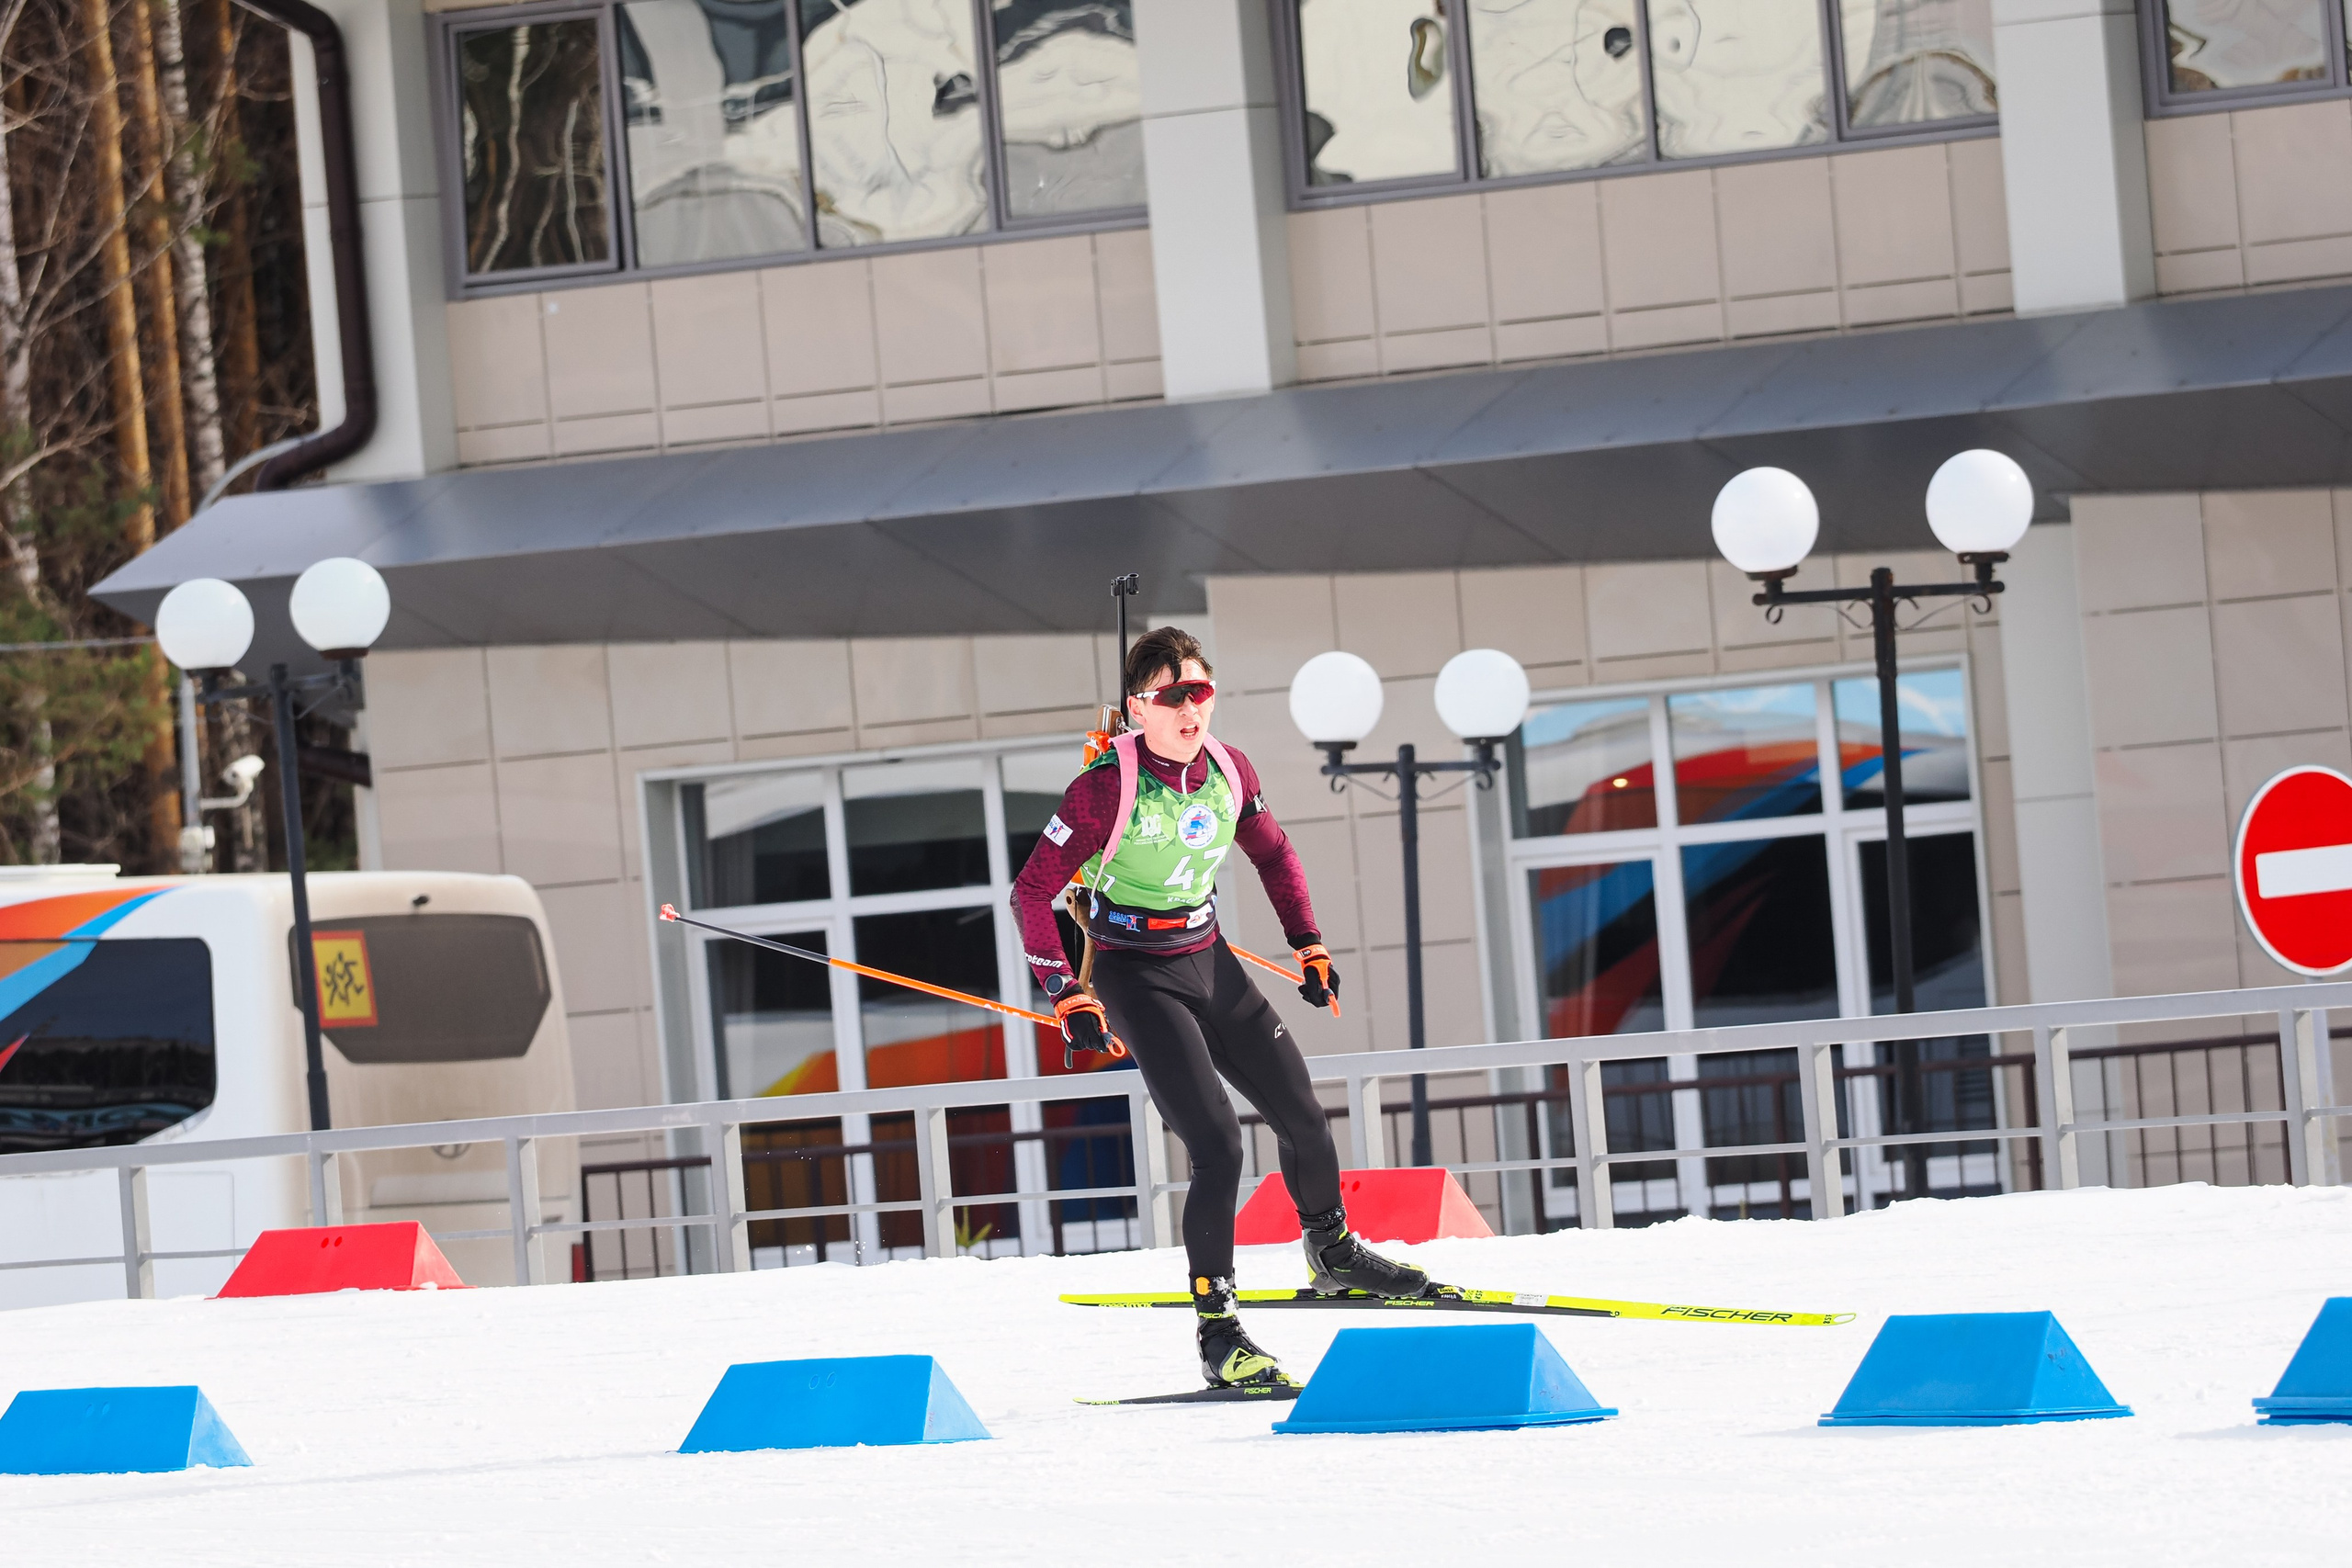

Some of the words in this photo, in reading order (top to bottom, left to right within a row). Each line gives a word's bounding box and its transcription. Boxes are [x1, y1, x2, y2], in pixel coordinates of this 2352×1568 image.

[1163, 843, 1228, 891] 47
[1661, 1306, 1793, 1323] FISCHER
[1243, 1382, 1272, 1394] FISCHER
